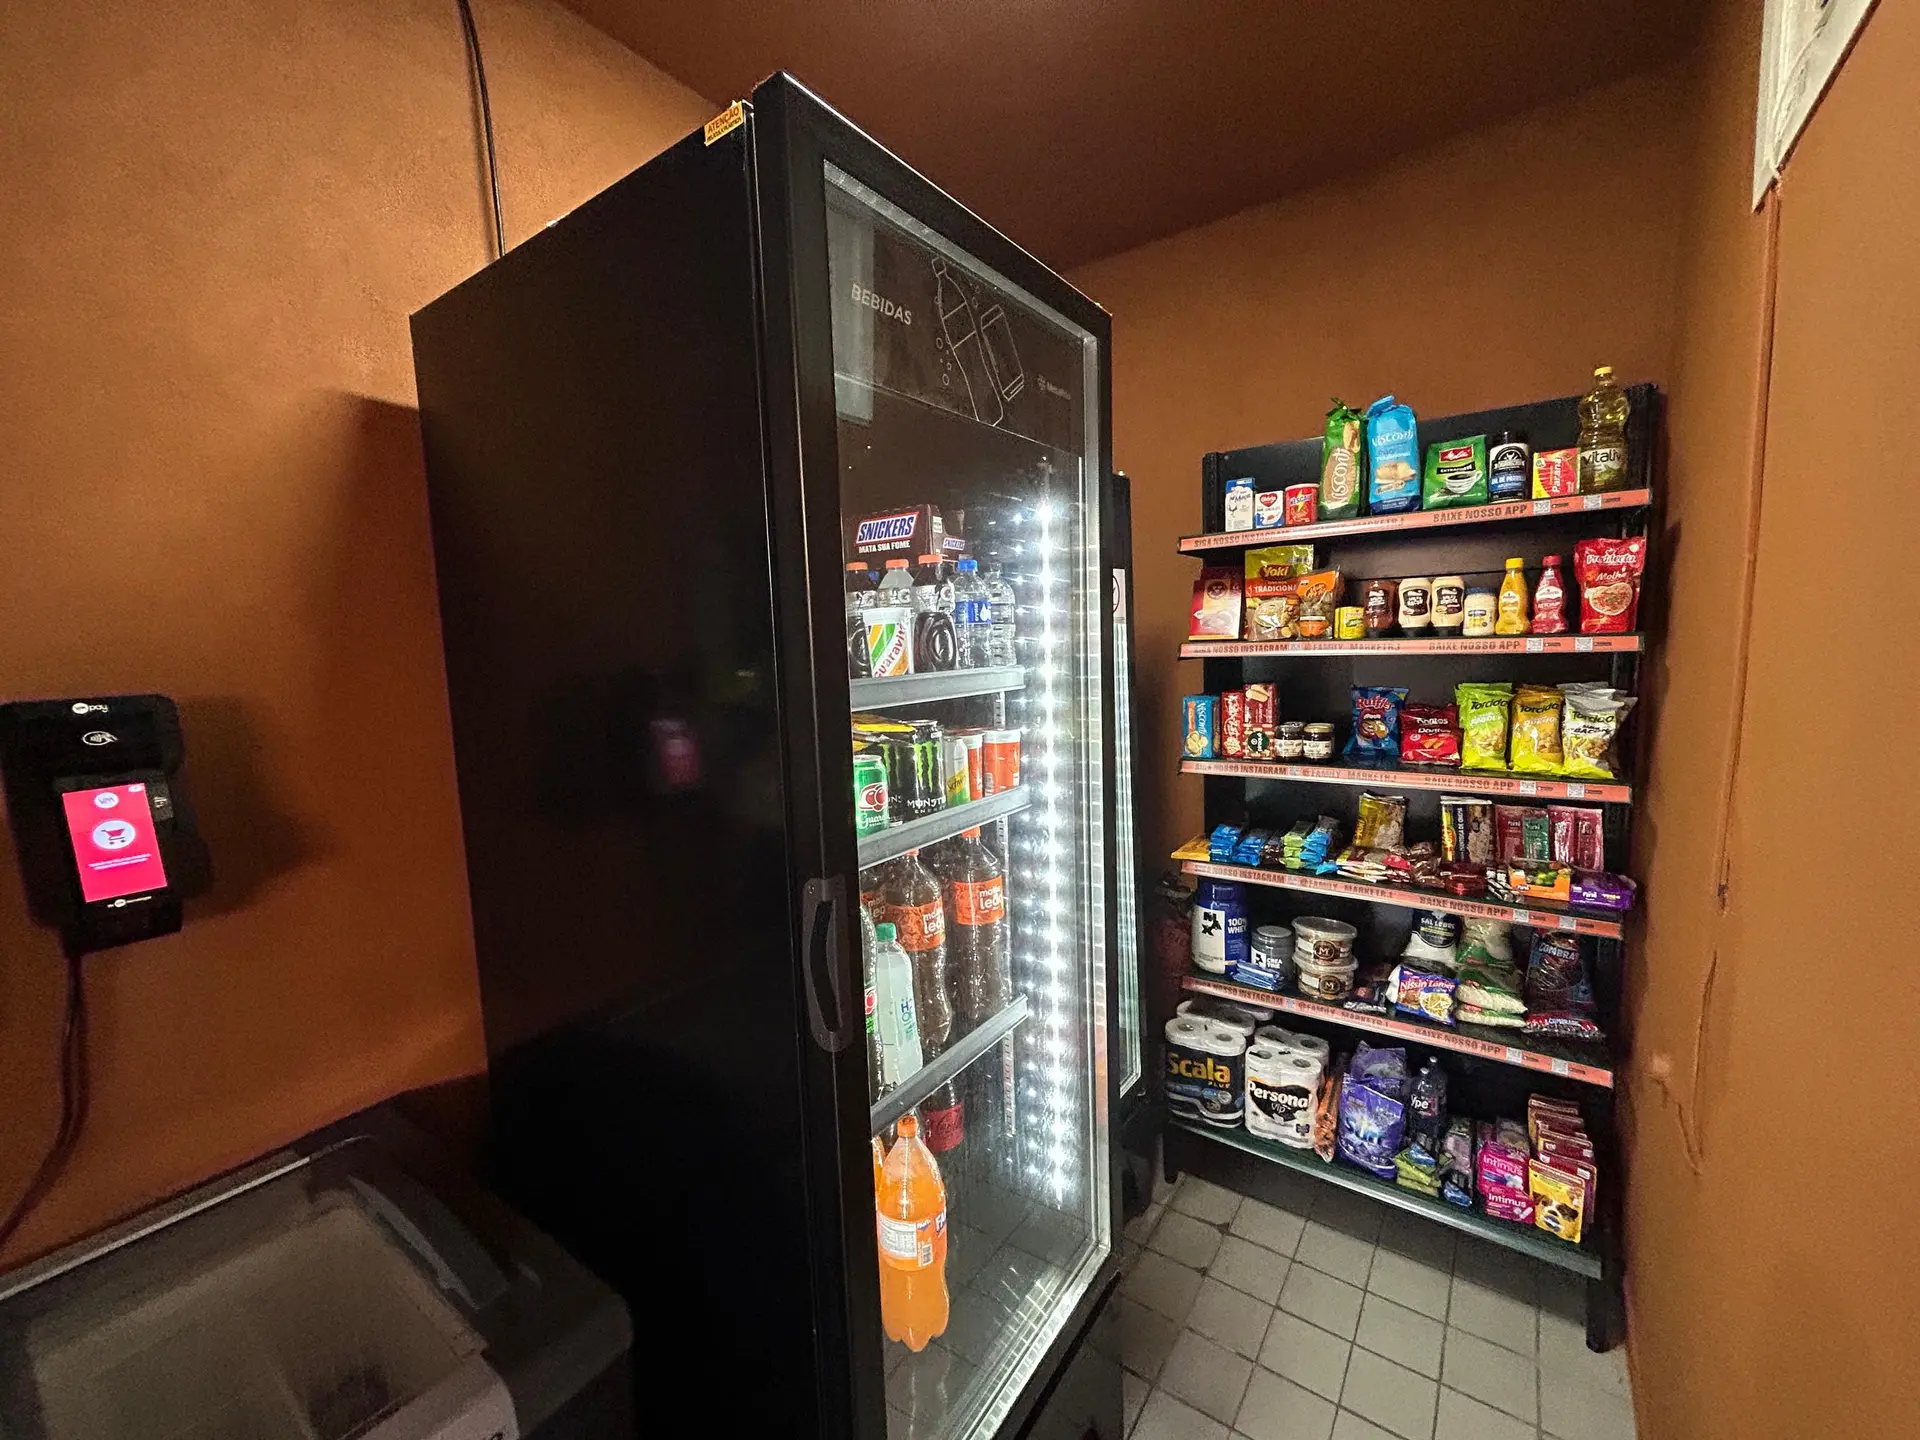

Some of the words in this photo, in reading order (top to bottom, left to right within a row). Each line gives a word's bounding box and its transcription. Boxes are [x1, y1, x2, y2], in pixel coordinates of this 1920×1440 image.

[851, 283, 912, 325] BEBIDAS
[1433, 512, 1463, 523] BAIXE
[1465, 507, 1502, 519] NOSSO
[1505, 504, 1528, 515] APP
[858, 516, 914, 541] SNICKERS
[859, 543, 877, 554] MATA
[877, 543, 891, 552] SUA
[891, 540, 911, 550] FOME
[1213, 535, 1240, 545] NOSSO
[1240, 644, 1288, 653] INSTAGRAM
[1460, 641, 1496, 650] NOSSO
[1498, 640, 1521, 650] APP
[1240, 765, 1287, 775] INSTAGRAM
[1240, 869, 1285, 884] INSTAGRAM
[1450, 901, 1484, 914] NOSSO
[1487, 907, 1508, 917] APP
[1480, 1043, 1501, 1054] APP
[1168, 1052, 1231, 1084] Scala
[1248, 1081, 1312, 1108] Personal
[1488, 1193, 1527, 1208] Intimus
